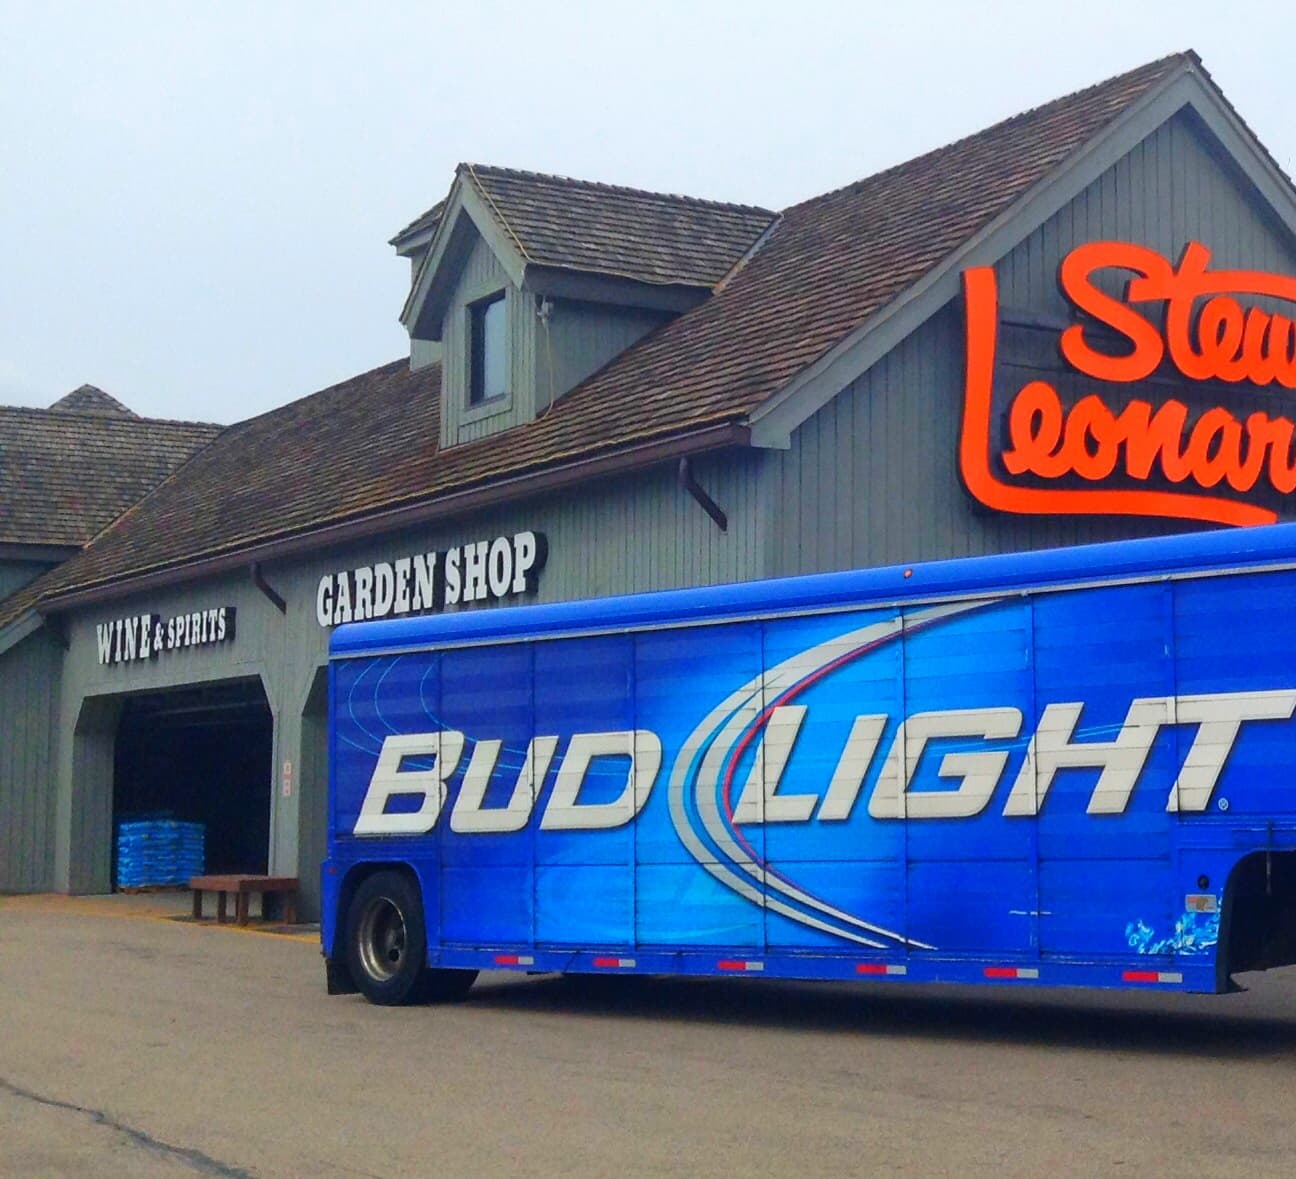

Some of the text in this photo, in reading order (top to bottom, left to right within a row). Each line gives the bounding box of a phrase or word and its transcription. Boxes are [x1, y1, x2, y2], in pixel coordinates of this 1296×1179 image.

[316, 531, 536, 627] GARDEN SHOP
[96, 607, 226, 664] WINE & SPIRITS
[353, 730, 662, 837] BUD
